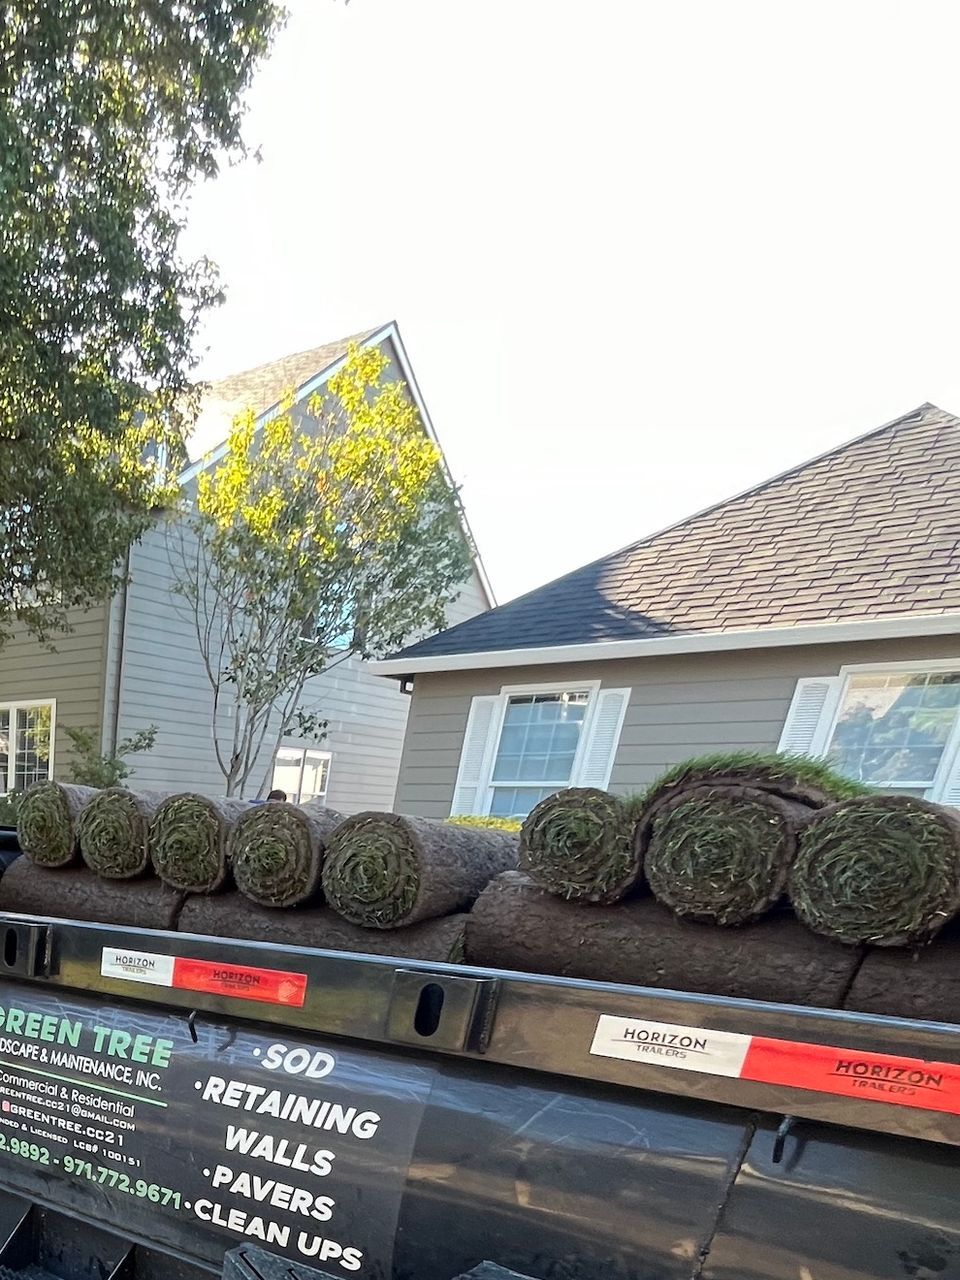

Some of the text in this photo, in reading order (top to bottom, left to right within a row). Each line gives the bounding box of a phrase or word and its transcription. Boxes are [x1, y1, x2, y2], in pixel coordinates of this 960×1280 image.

[115, 955, 155, 969] HORIZON
[213, 969, 261, 985] HORIZON
[93, 1025, 175, 1069] TREE
[624, 1027, 708, 1051] HORIZON
[635, 1044, 687, 1059] TRAILERS
[40, 1049, 49, 1063] &
[49, 1050, 134, 1085] MAINTENANCE,
[136, 1069, 162, 1092] INC.
[835, 1059, 944, 1087] HORIZON
[59, 1086, 69, 1100] &
[72, 1088, 135, 1118] Residential
[21, 1123, 28, 1132] &
[102, 1148, 141, 1168] 100151
[225, 1124, 337, 1177] WALLS
[63, 1155, 182, 1210] 971.772.9671
[297, 1231, 365, 1272] UPS
